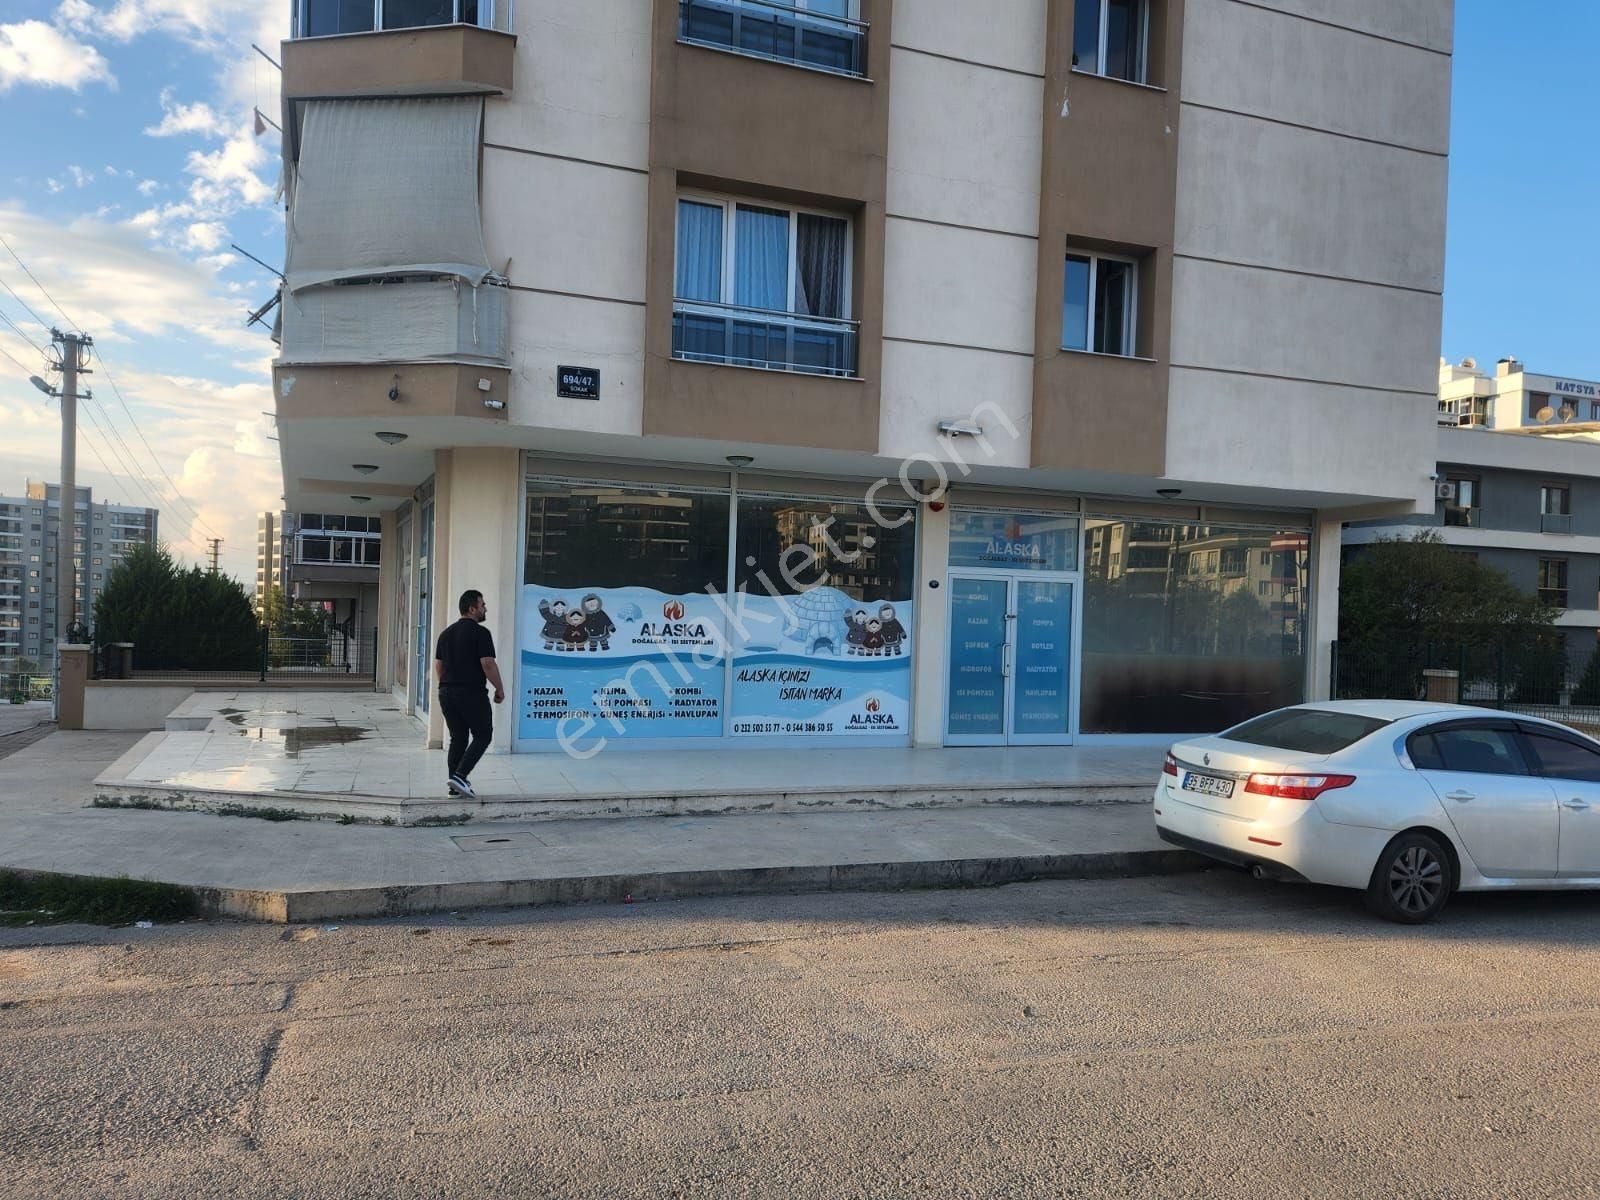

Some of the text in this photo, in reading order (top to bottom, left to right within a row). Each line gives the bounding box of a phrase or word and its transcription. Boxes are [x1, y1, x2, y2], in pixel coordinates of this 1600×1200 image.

[986, 542, 1040, 557] ALASKA
[640, 623, 706, 638] ALASKA
[737, 668, 777, 682] ALASKA
[780, 686, 842, 701] ISITAN MARKA
[674, 710, 718, 718] HAVLUPAN
[850, 714, 894, 724] ALASKA
[734, 724, 739, 732] 0
[740, 724, 751, 732] 232
[752, 724, 764, 732] 502
[765, 724, 772, 732] 55
[773, 723, 780, 732] 77
[786, 723, 791, 732] 0
[792, 723, 803, 732] 544
[817, 723, 825, 732] 50
[826, 723, 833, 732] 55
[1189, 775, 1199, 786] 35
[1216, 780, 1231, 793] 430
